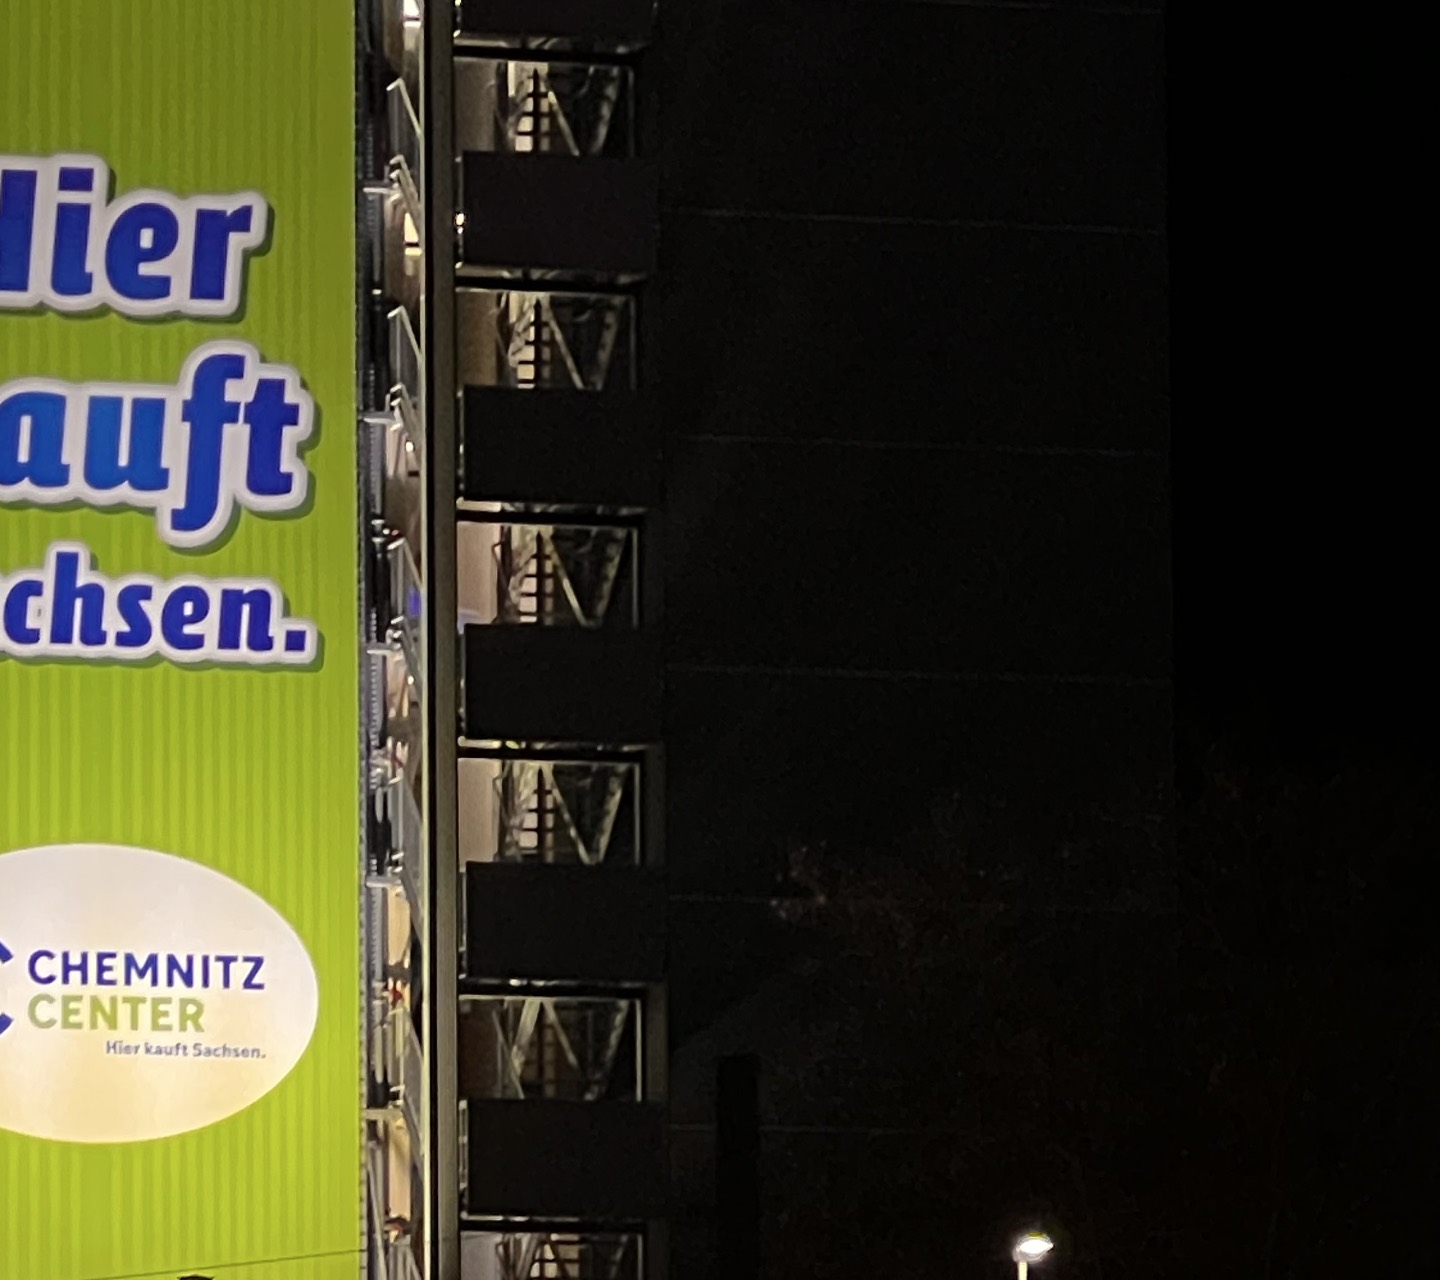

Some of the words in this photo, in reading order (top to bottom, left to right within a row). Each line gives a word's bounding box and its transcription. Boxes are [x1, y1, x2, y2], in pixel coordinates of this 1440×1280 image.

[27, 949, 266, 990] CHEMNITZ
[27, 993, 205, 1033] CENTER
[105, 1039, 140, 1056] Hier
[144, 1041, 189, 1058] kauft
[192, 1043, 267, 1060] Sachsen.
